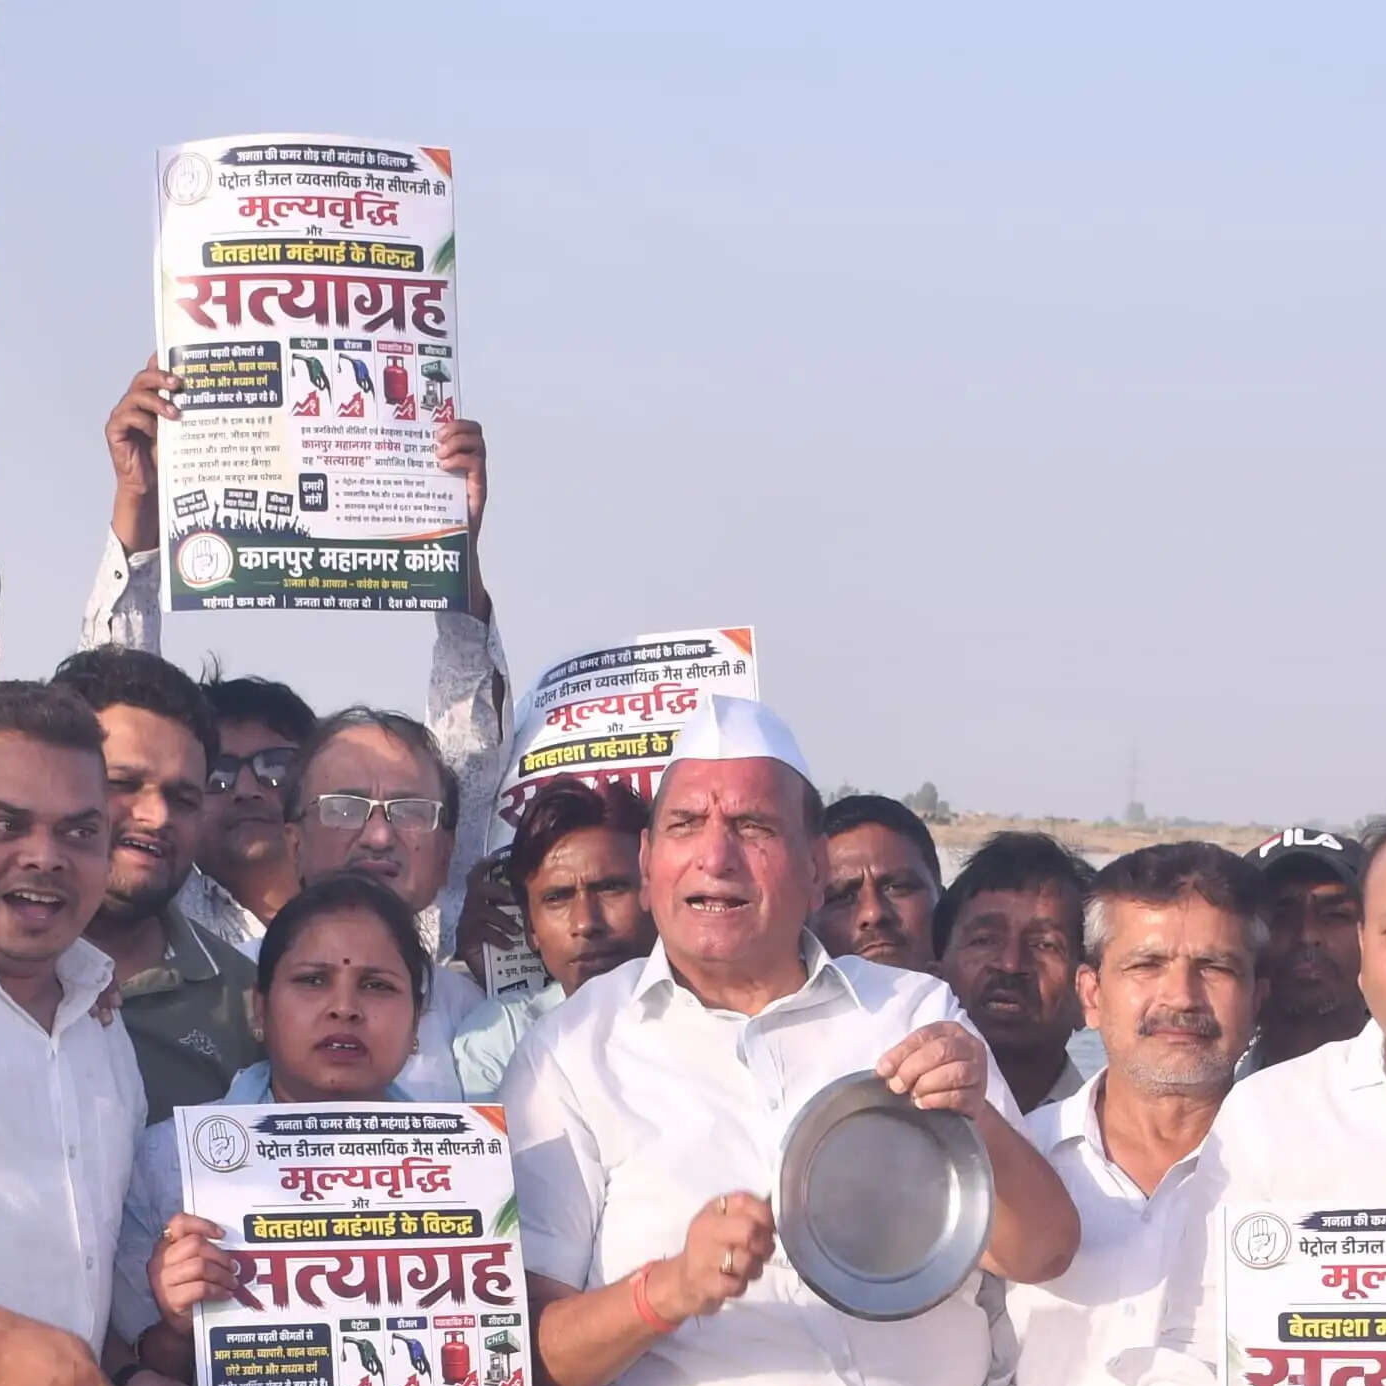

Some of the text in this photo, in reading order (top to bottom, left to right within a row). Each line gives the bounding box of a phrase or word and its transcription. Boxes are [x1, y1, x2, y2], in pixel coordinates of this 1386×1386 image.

[218, 169, 445, 197] पेट्रोल डीजल व्यवसायिक गैस सीएनजी की
[238, 190, 399, 228] मूल्यवृद्धि
[306, 224, 323, 236] और
[210, 240, 415, 268] बेतहाशा महंगाई के विरुद्ध
[175, 272, 448, 339] सत्याग्रह
[237, 543, 460, 577] कानपुर महानगर कांग्रेस
[595, 661, 747, 690] व्यवसायिक गैस सीएनजी की
[545, 683, 699, 731] मूल्यवृद्धि
[524, 735, 667, 772] बेतहाशा महंगाई के
[1259, 828, 1343, 858] FILA
[256, 1138, 502, 1160] पेट्रोल डीजल व्यवसायिक गैस सीएनजी की
[278, 1157, 452, 1200] मूल्यवृद्धि
[352, 1197, 369, 1209] और
[252, 1212, 473, 1239] बेतहाशा महंगाई के विरुद्ध
[1321, 1216, 1352, 1227] जनता
[1353, 1212, 1368, 1226] की
[1299, 1237, 1337, 1257] पेट्रोल
[1341, 1236, 1385, 1254] डीजल
[228, 1243, 513, 1311] सत्याग्रह
[486, 1333, 505, 1345] CNG
[1288, 1314, 1370, 1339] बेतहाशा
